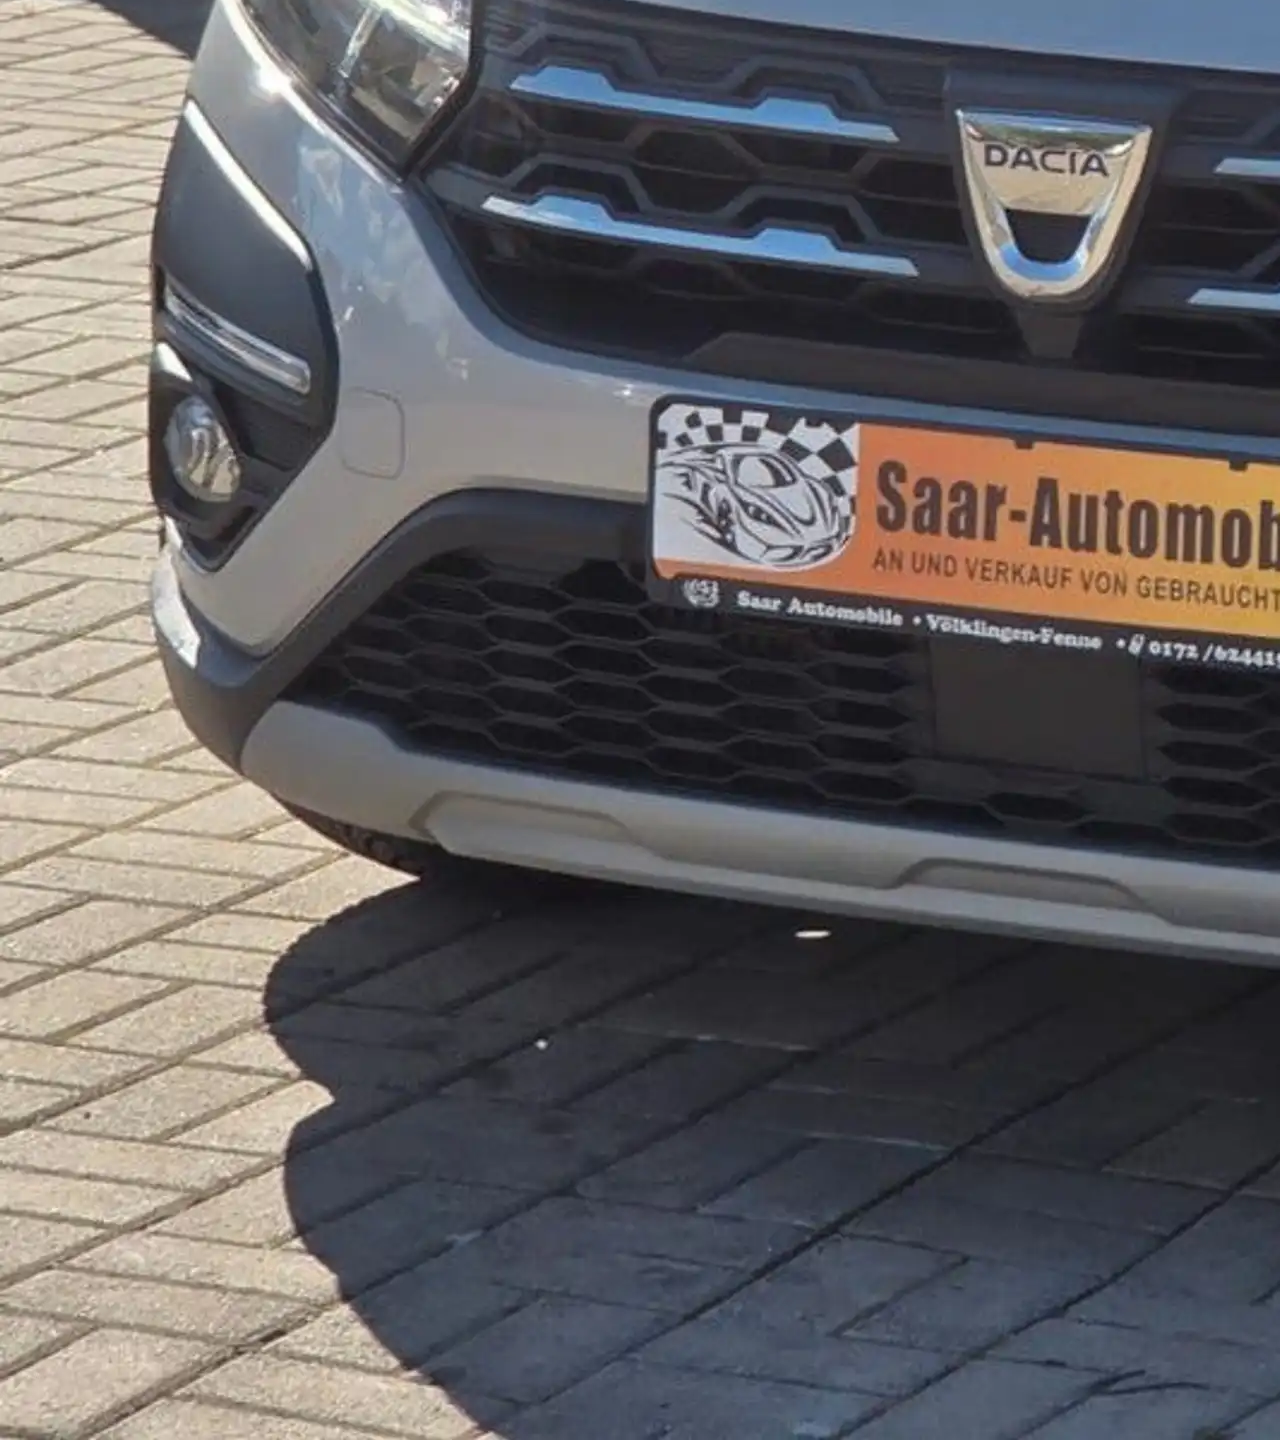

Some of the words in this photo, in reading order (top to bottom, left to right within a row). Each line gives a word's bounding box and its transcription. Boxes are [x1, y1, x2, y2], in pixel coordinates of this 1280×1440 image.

[984, 144, 1109, 177] DACIA
[872, 547, 903, 573] AN
[911, 553, 957, 578] UND
[965, 558, 1072, 589] VERKAUF
[1079, 569, 1127, 596] VON
[737, 590, 781, 611] Saar
[787, 597, 903, 627] Automobile
